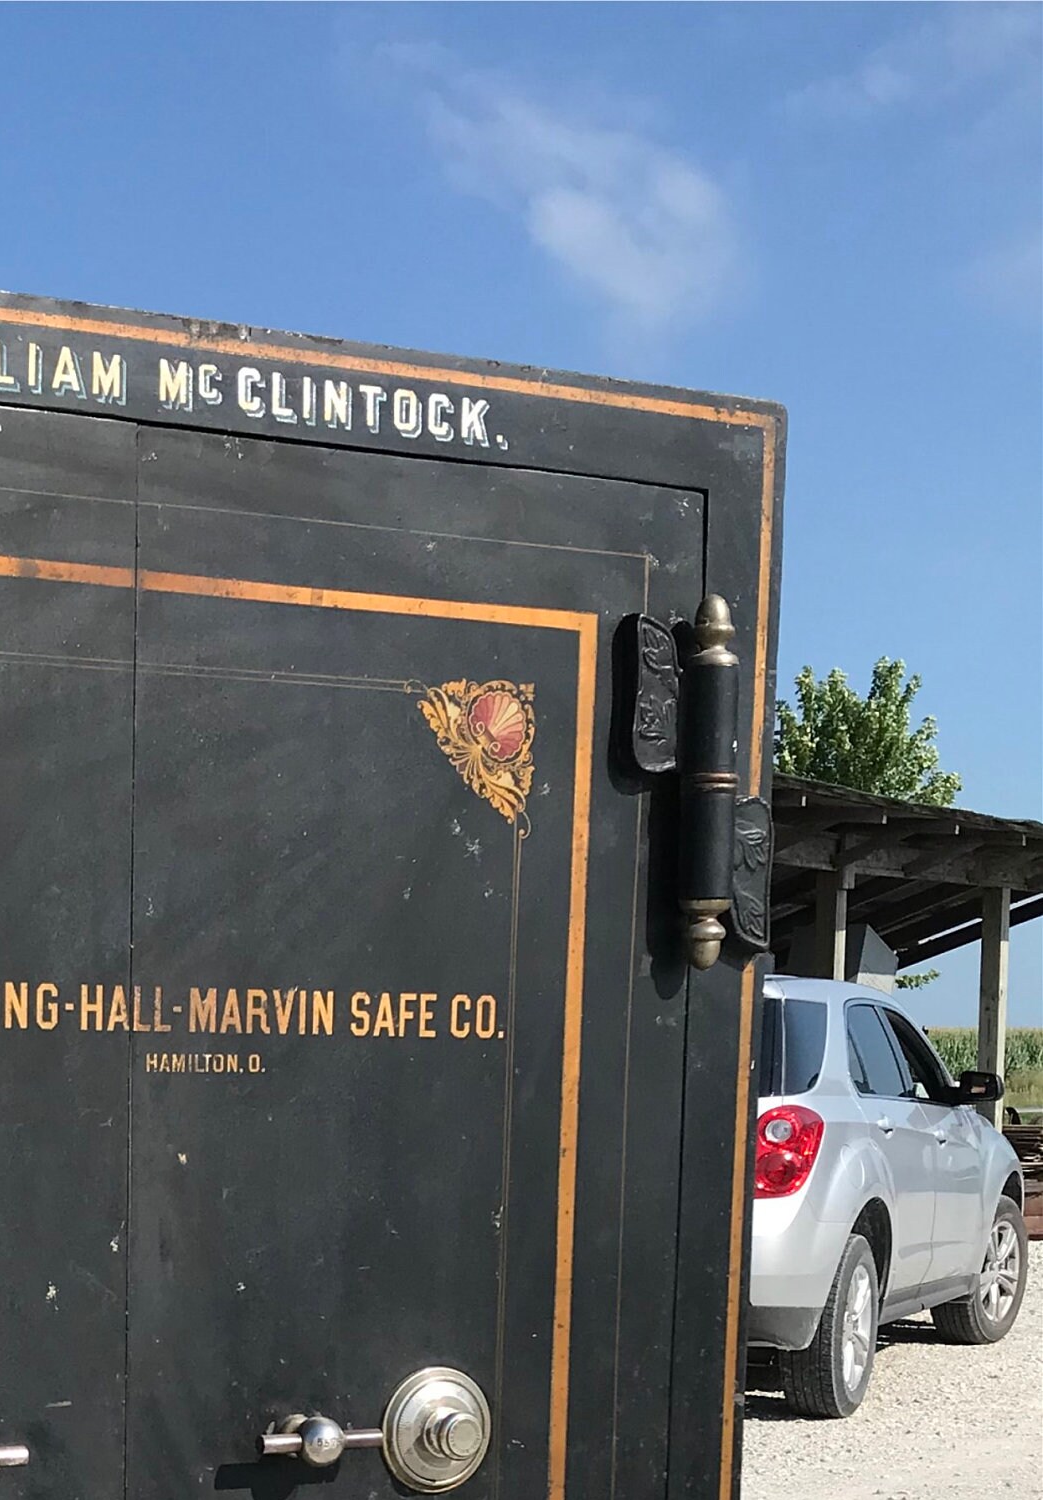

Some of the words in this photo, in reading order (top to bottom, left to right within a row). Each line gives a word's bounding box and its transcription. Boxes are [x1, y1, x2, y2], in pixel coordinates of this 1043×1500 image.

[350, 991, 437, 1039] SAFE
[449, 994, 505, 1040] CO.
[248, 1054, 266, 1073] O.
